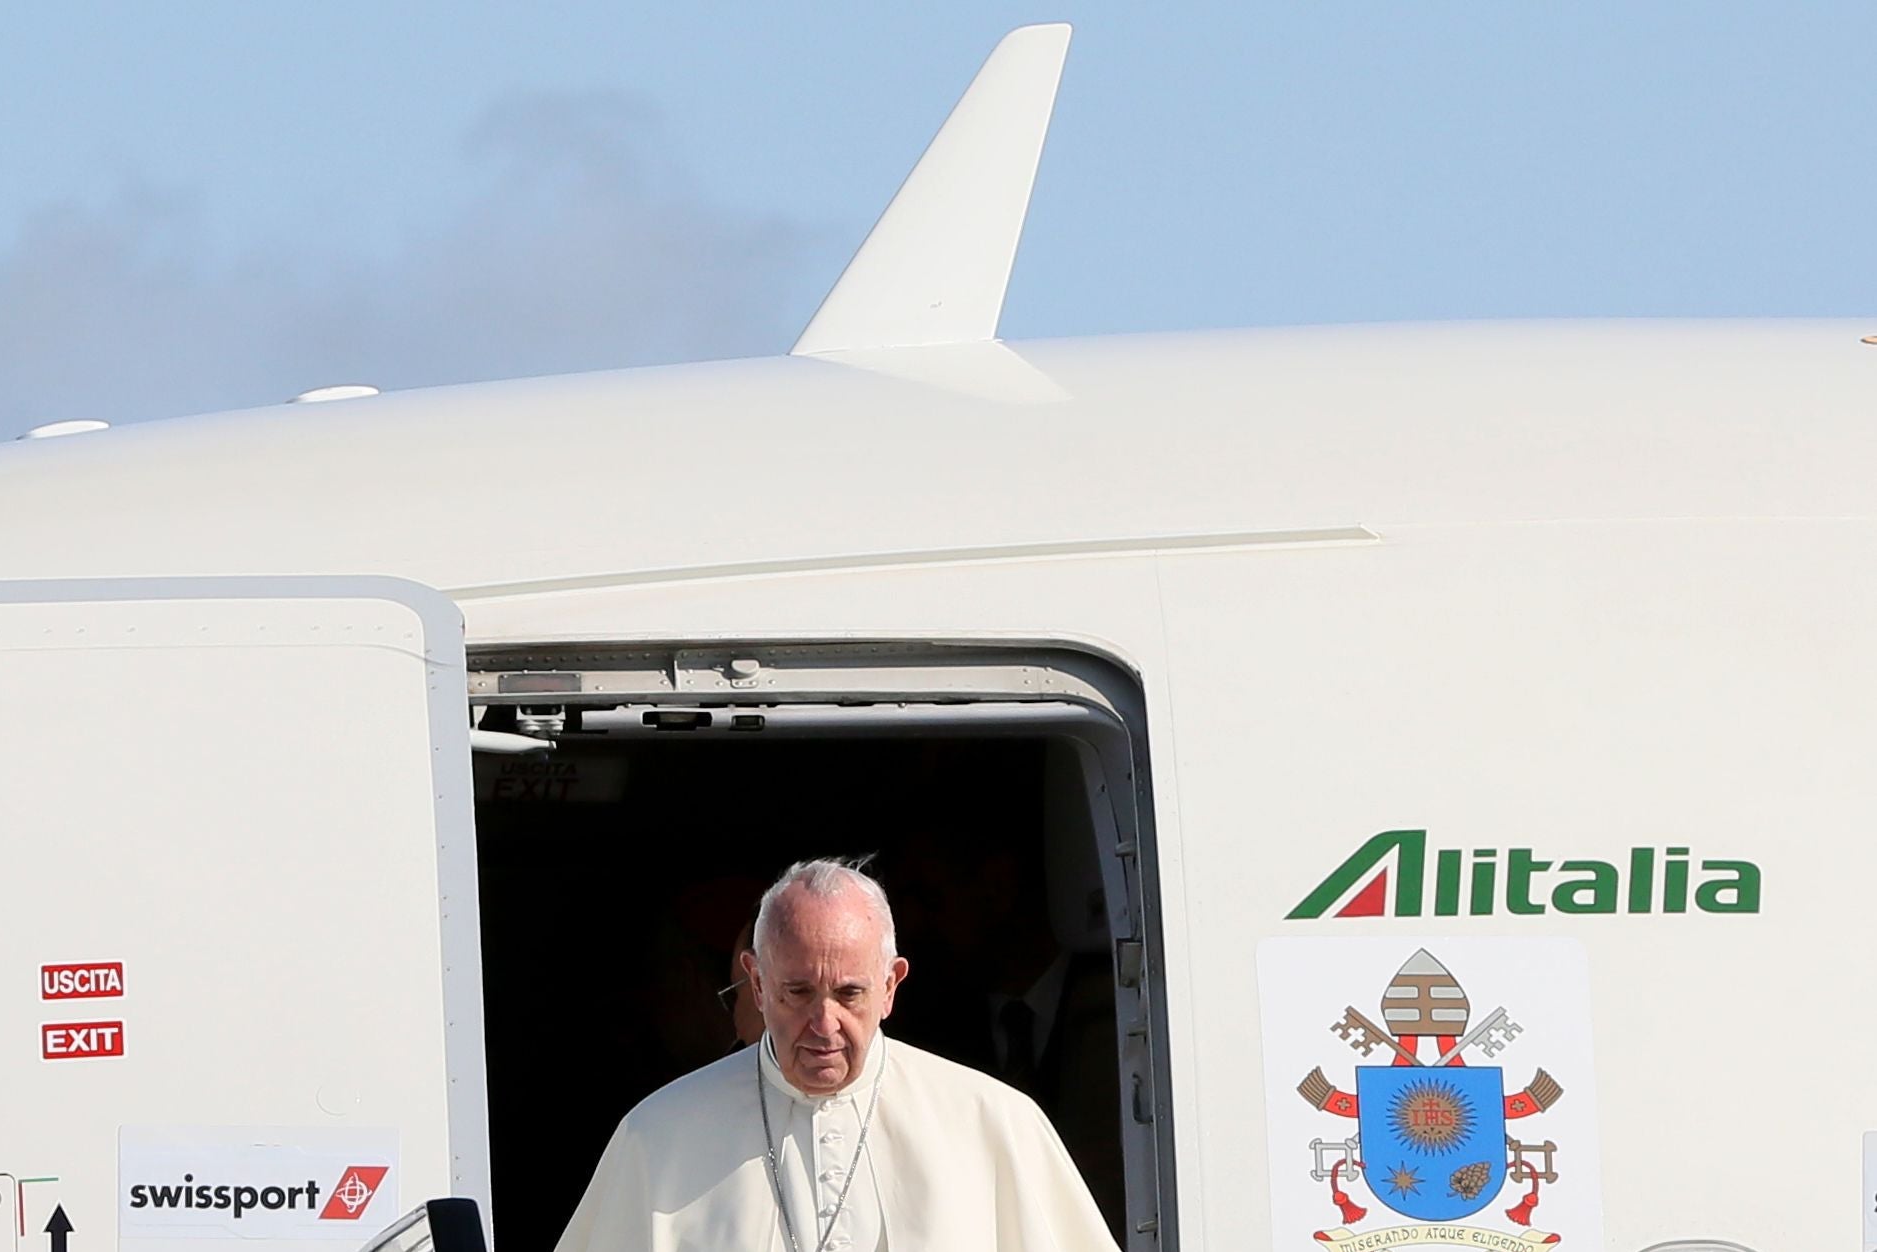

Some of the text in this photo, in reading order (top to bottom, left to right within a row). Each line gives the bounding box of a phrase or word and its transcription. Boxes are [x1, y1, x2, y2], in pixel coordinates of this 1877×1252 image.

[491, 777, 580, 801] EXIT
[1282, 829, 1762, 920] Alitalia
[43, 967, 122, 994] USCITA
[45, 1026, 119, 1053] EXIT
[129, 1173, 320, 1219] swissport
[1425, 1226, 1465, 1240] ATQUE
